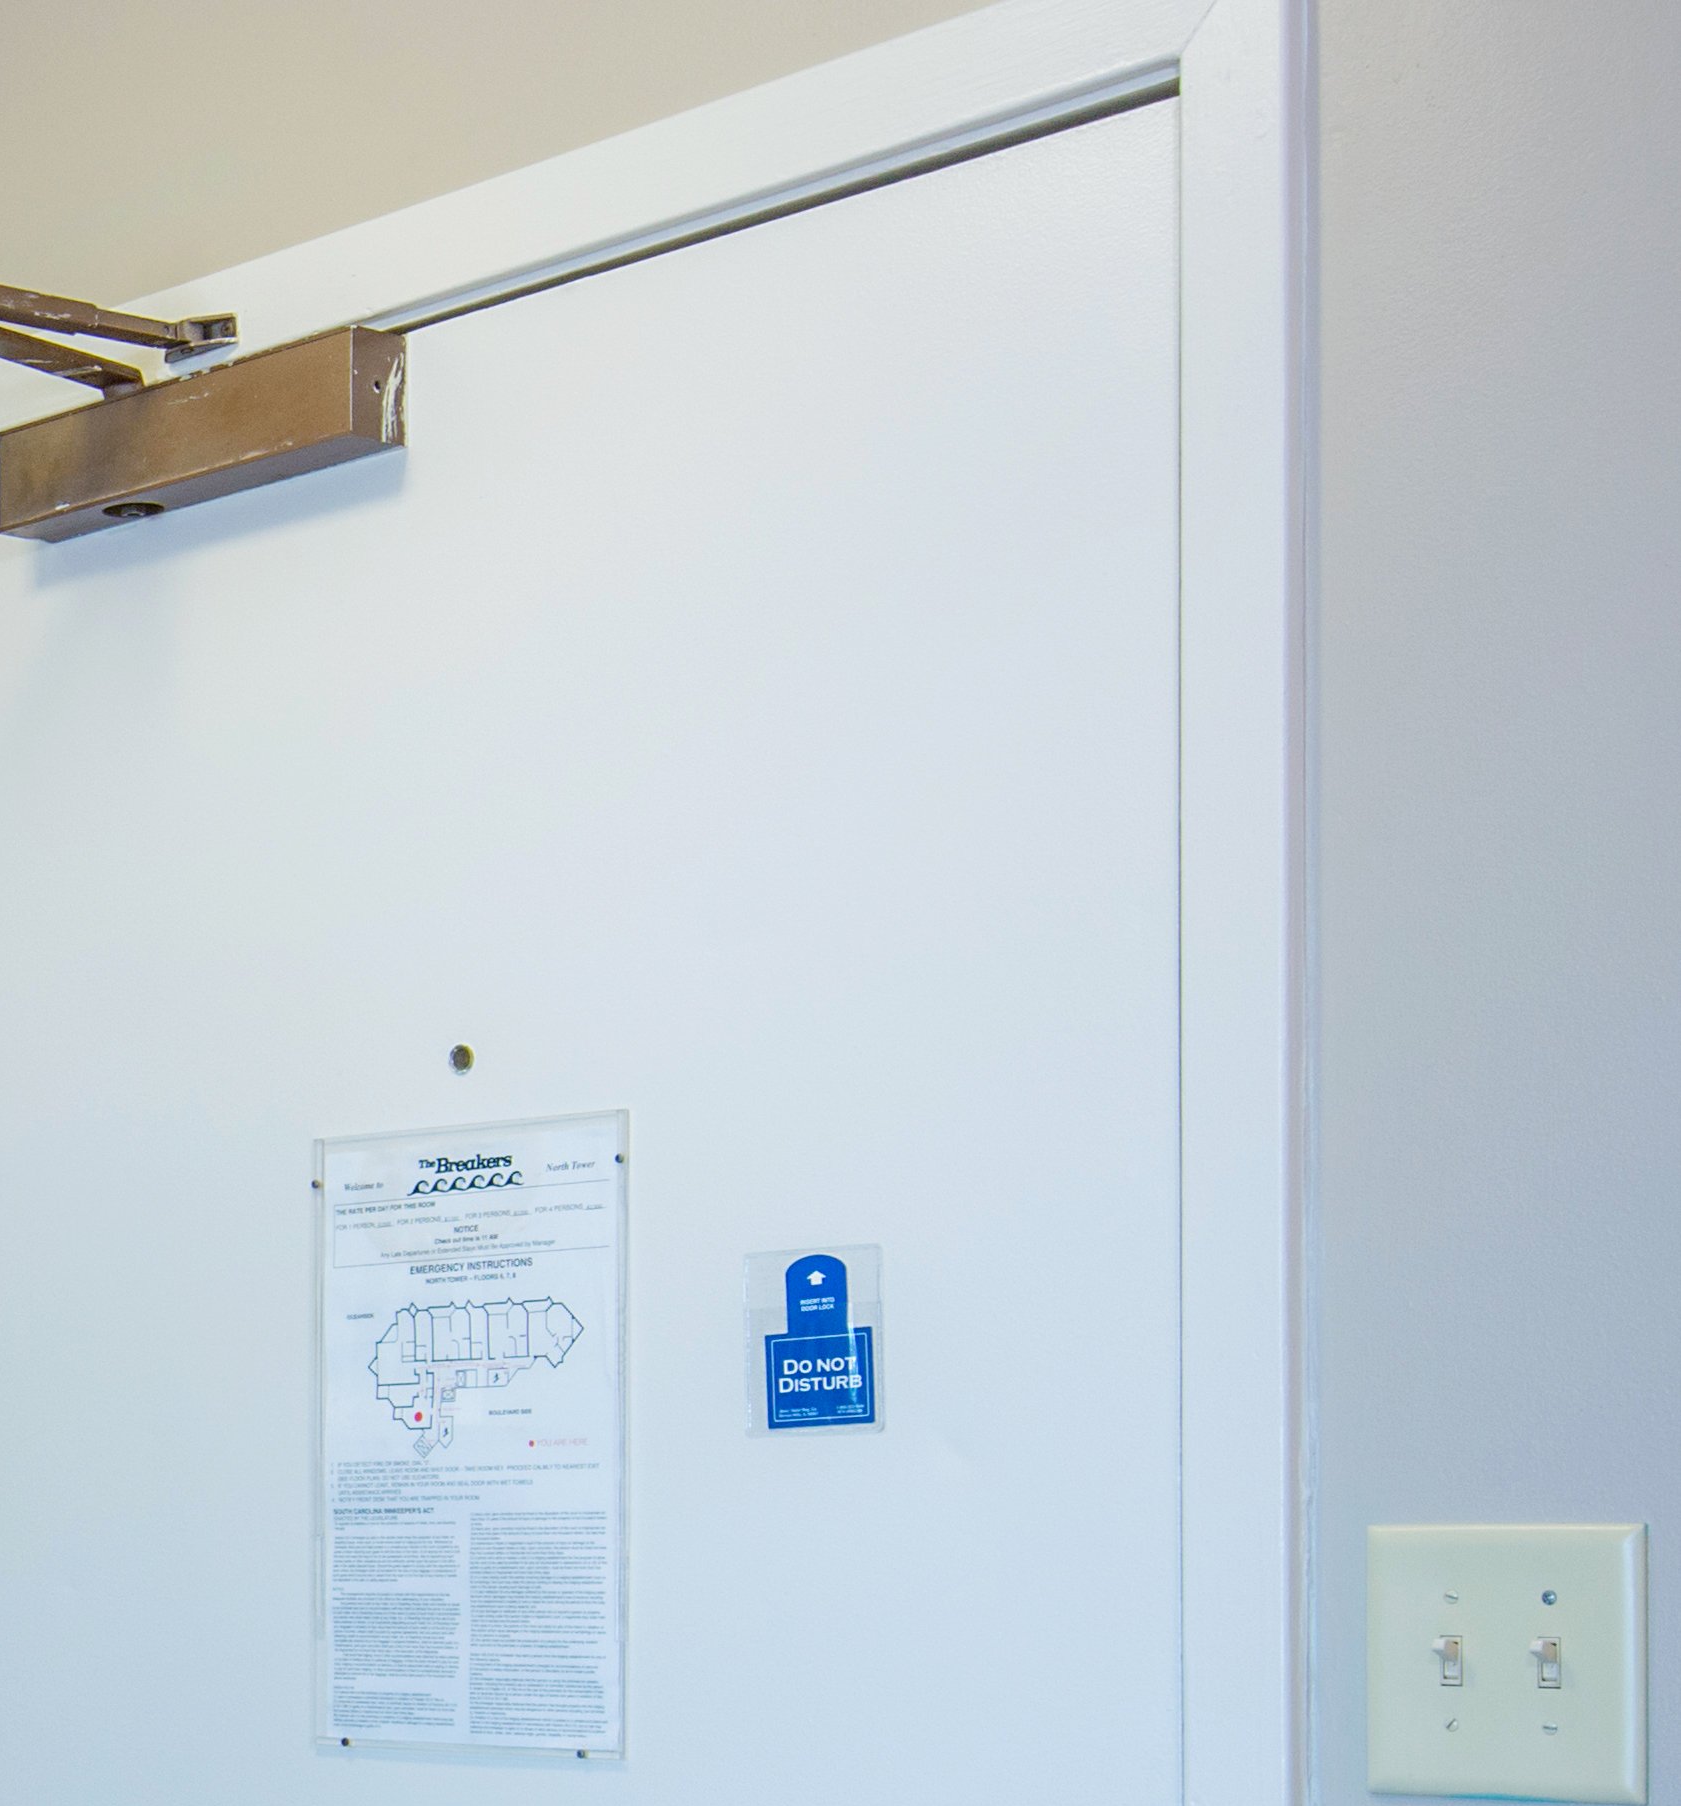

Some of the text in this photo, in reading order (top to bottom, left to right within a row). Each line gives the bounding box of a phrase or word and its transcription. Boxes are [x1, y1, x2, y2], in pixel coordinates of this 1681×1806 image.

[419, 1153, 513, 1174] The Breakers
[546, 1161, 595, 1172] North Tower
[454, 1225, 478, 1233] NOTICE
[410, 1257, 533, 1275] EMERGENCY INSTRUCTIONS
[447, 1275, 468, 1283] TOWER
[474, 1273, 498, 1281] FLOORS
[816, 1356, 857, 1373] NOT
[779, 1374, 862, 1394] DISTURB
